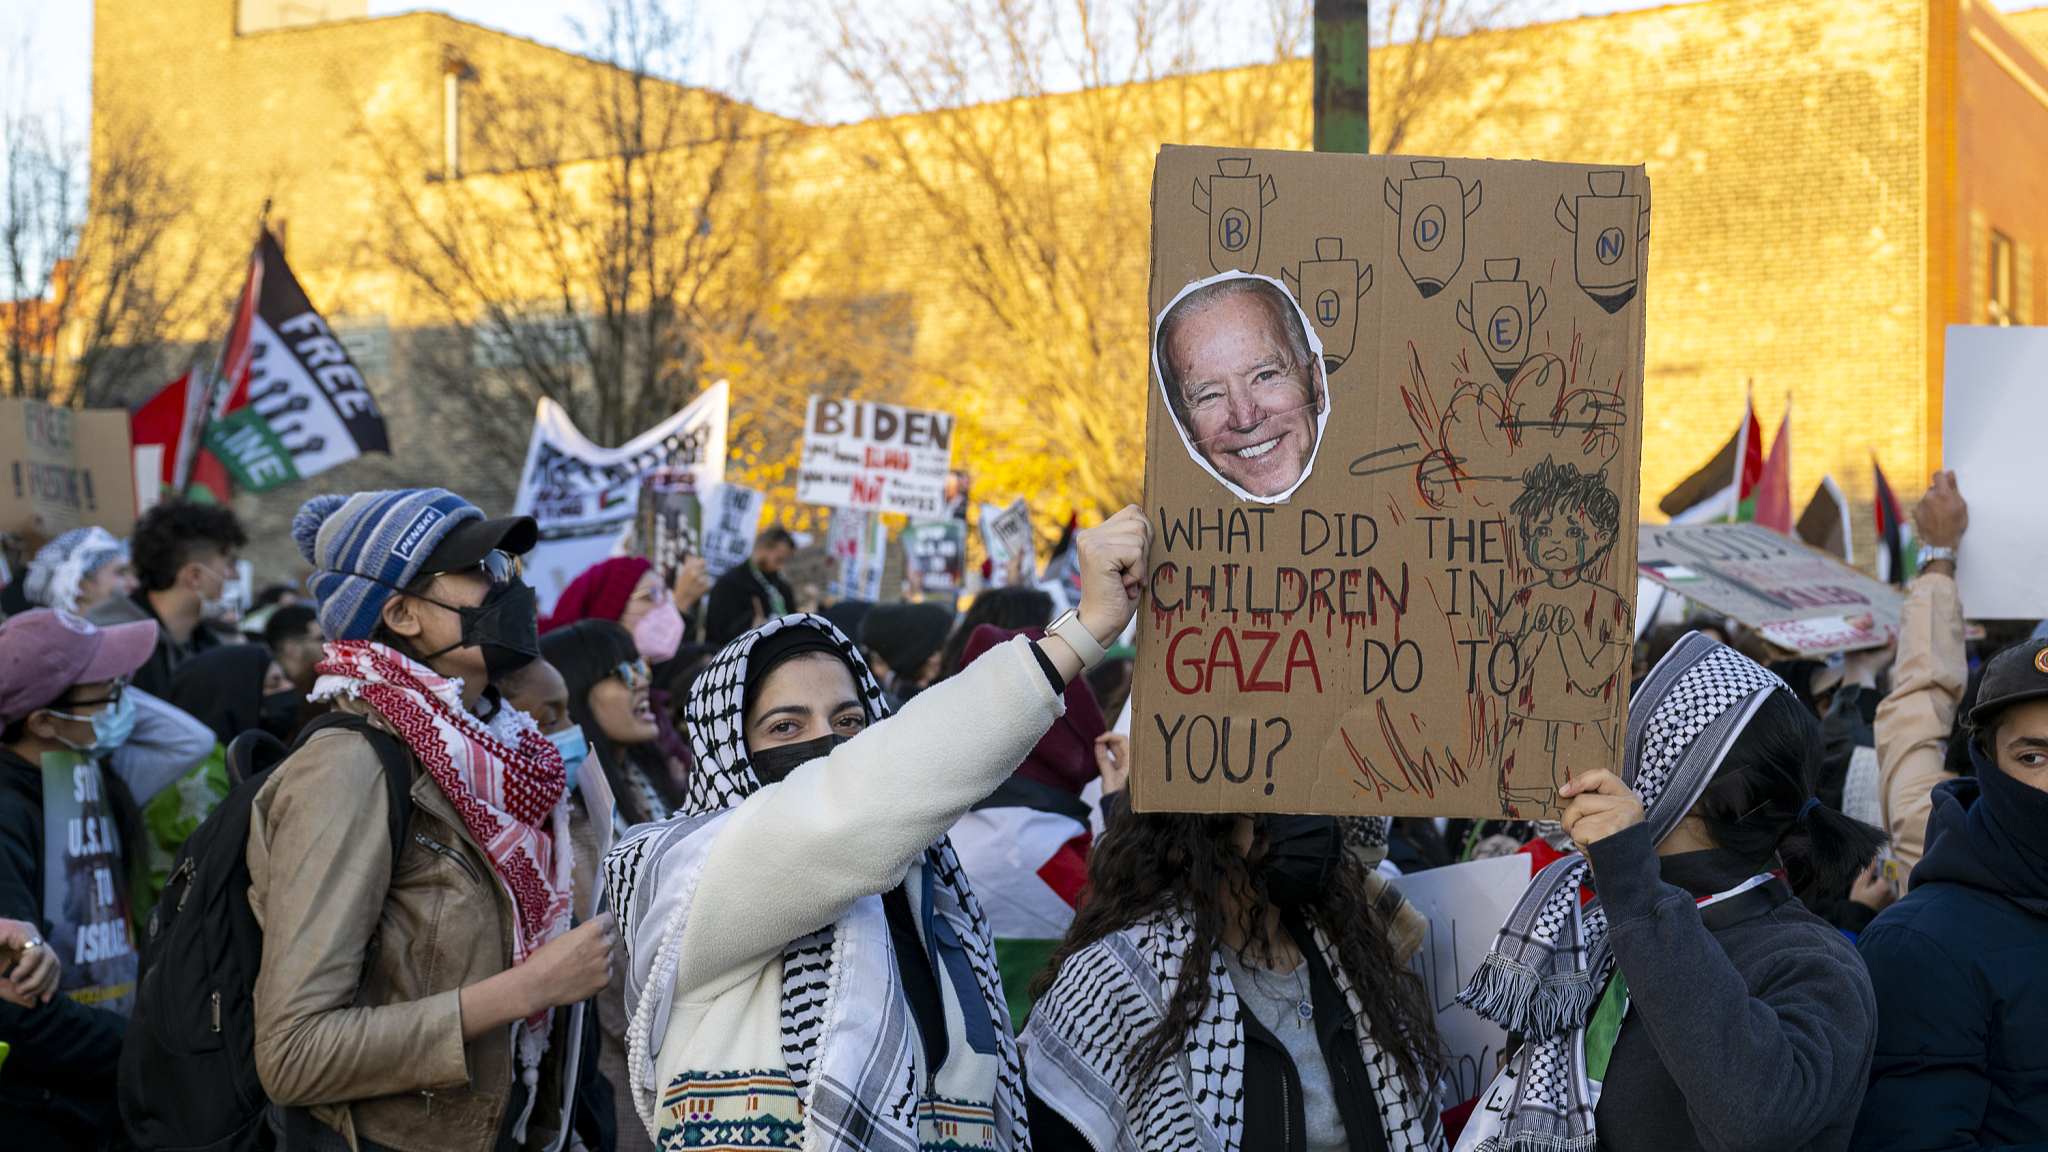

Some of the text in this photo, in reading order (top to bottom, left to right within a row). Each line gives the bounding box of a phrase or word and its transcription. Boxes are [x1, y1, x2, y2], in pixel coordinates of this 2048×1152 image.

[278, 310, 381, 419] FREE
[814, 399, 953, 450] BIDEN
[400, 510, 437, 555] PENSKE
[1160, 507, 1505, 564] WHAT DID THE
[1151, 562, 1505, 618] CHILDREN IN
[1166, 626, 1521, 696] GAZA DO TO
[1154, 713, 1291, 797] YOU?
